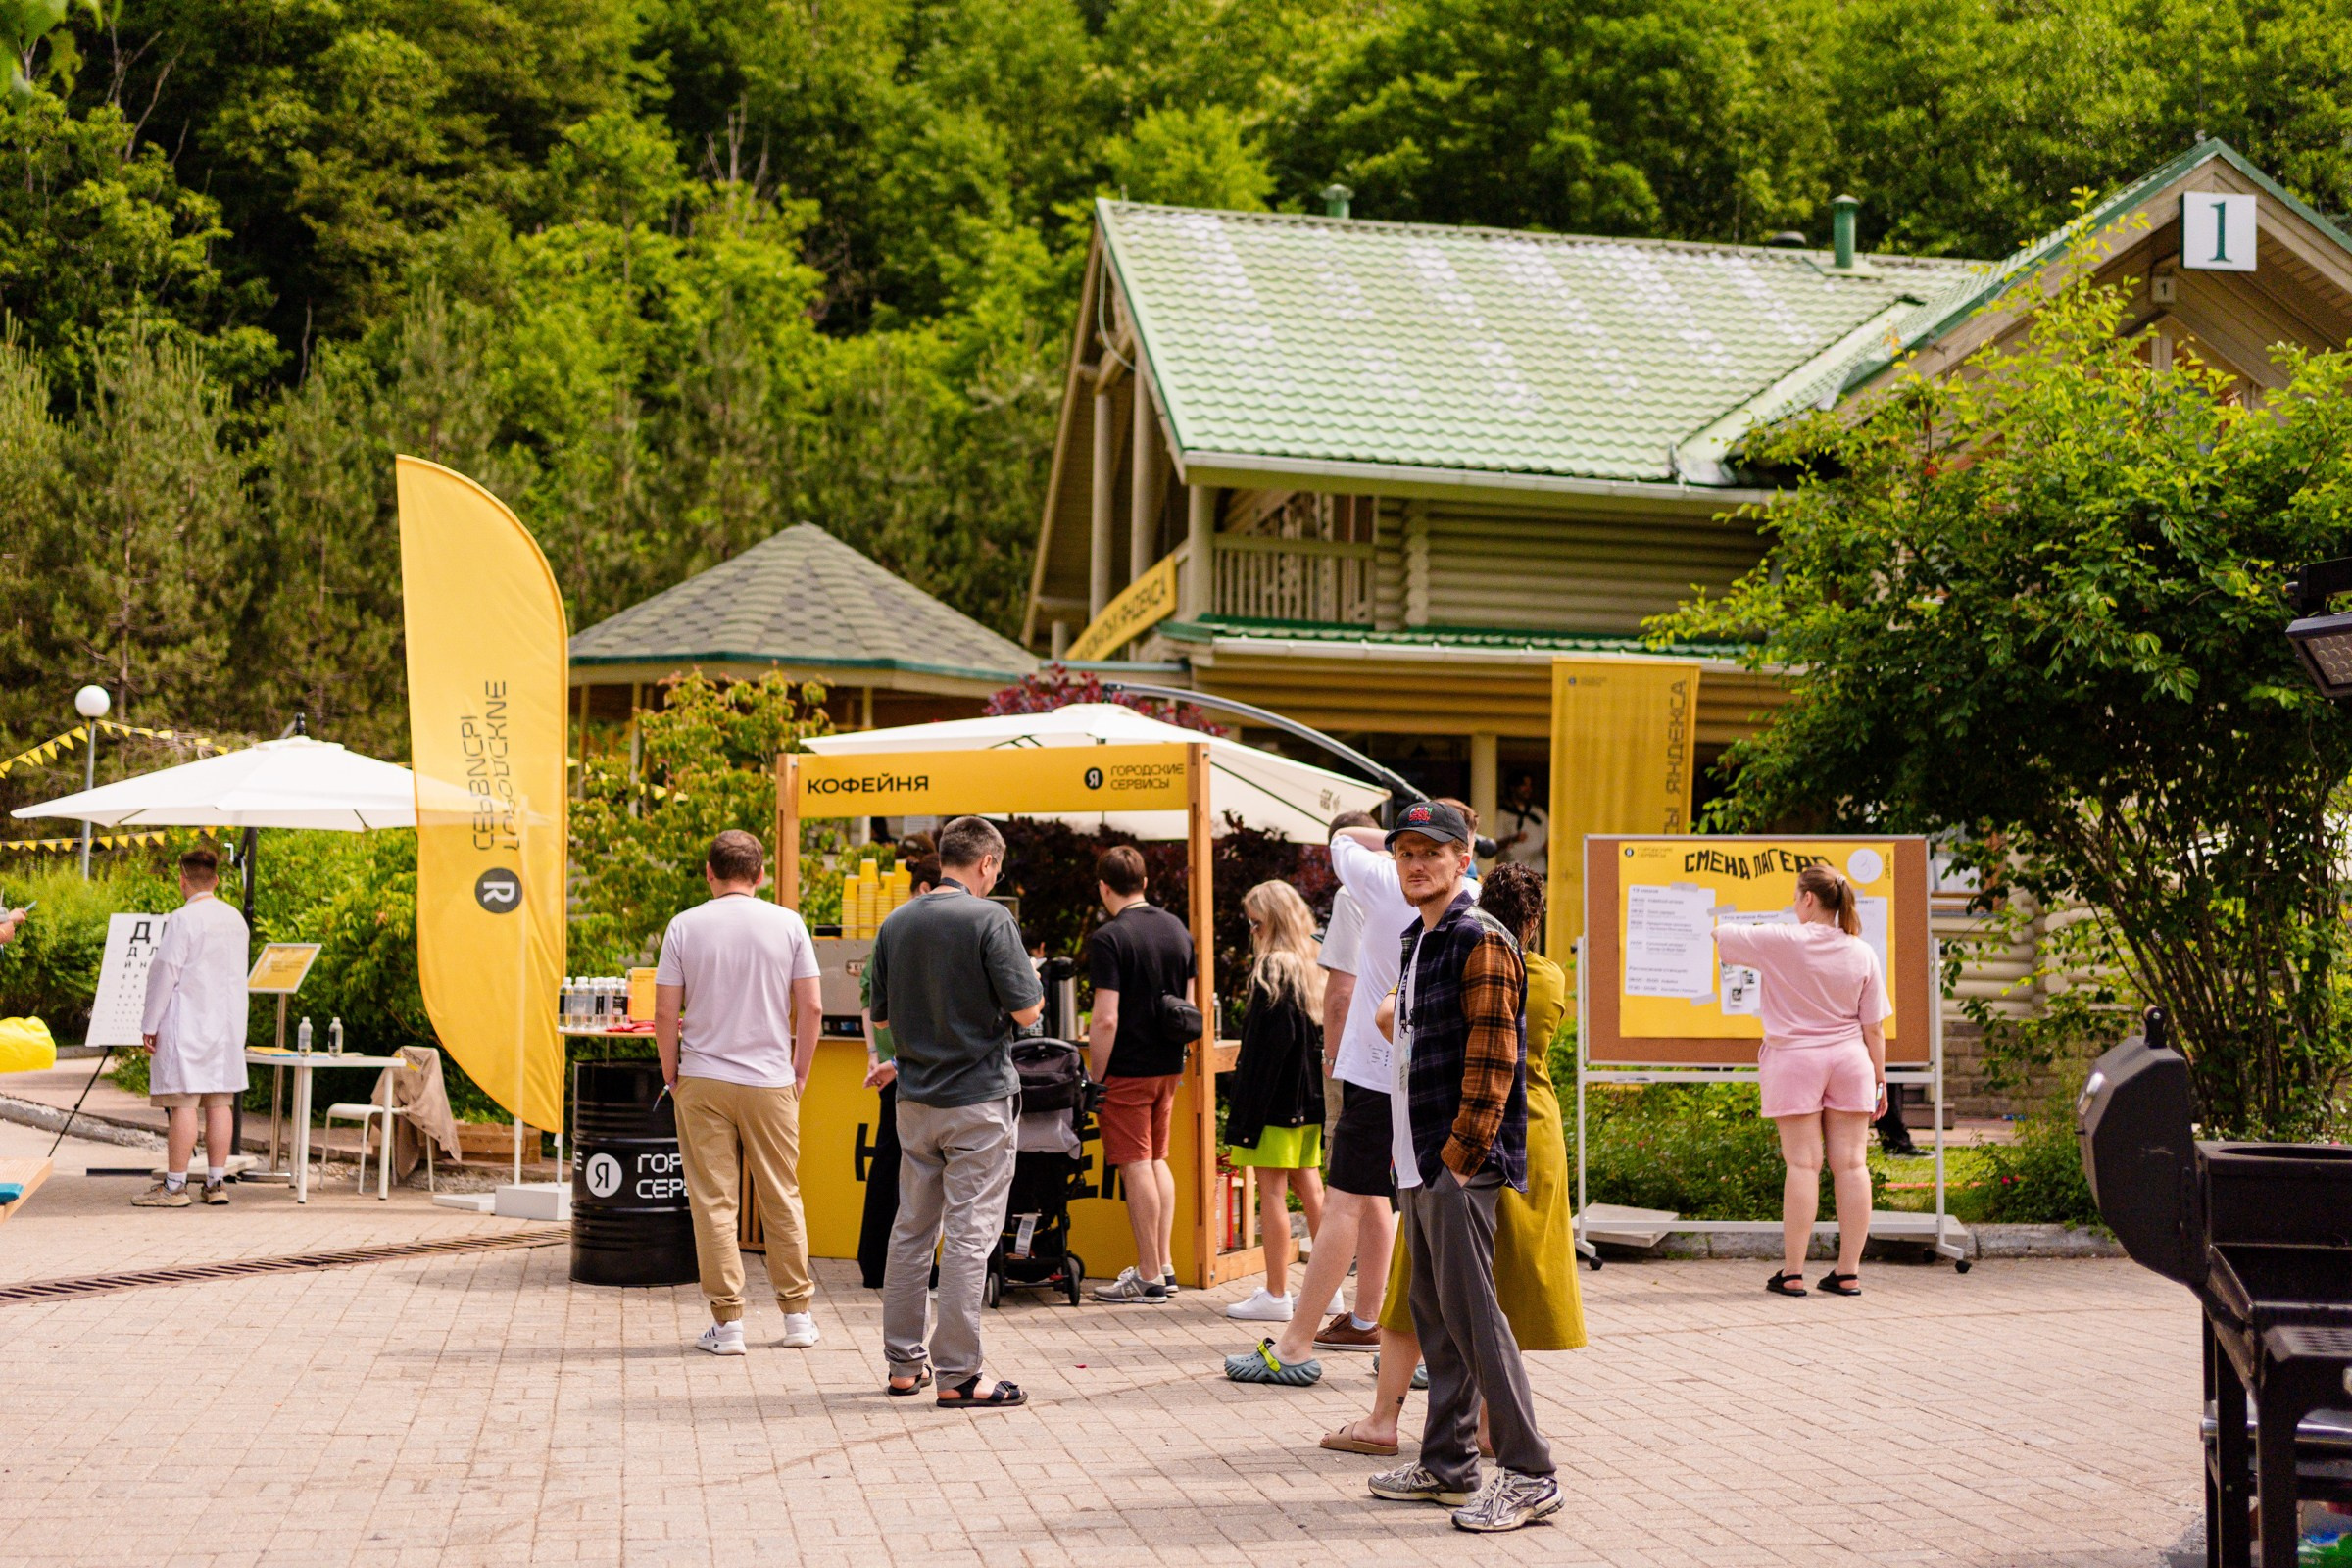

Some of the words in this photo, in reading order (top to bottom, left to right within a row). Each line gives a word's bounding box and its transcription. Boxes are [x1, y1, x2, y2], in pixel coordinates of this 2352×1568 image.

[2208, 201, 2232, 263] 1
[1666, 679, 1687, 795] ЯНДЕКСА
[1088, 770, 1100, 787] Я
[1110, 763, 1185, 776] ГОРОДСКИЕ
[808, 772, 929, 794] КОФЕЙНЯ
[1110, 778, 1170, 790] СЕРВИСЫ
[1685, 849, 1751, 881] СМЕНА
[129, 921, 151, 944] Д
[126, 946, 137, 957] Д
[595, 1162, 609, 1189] Я
